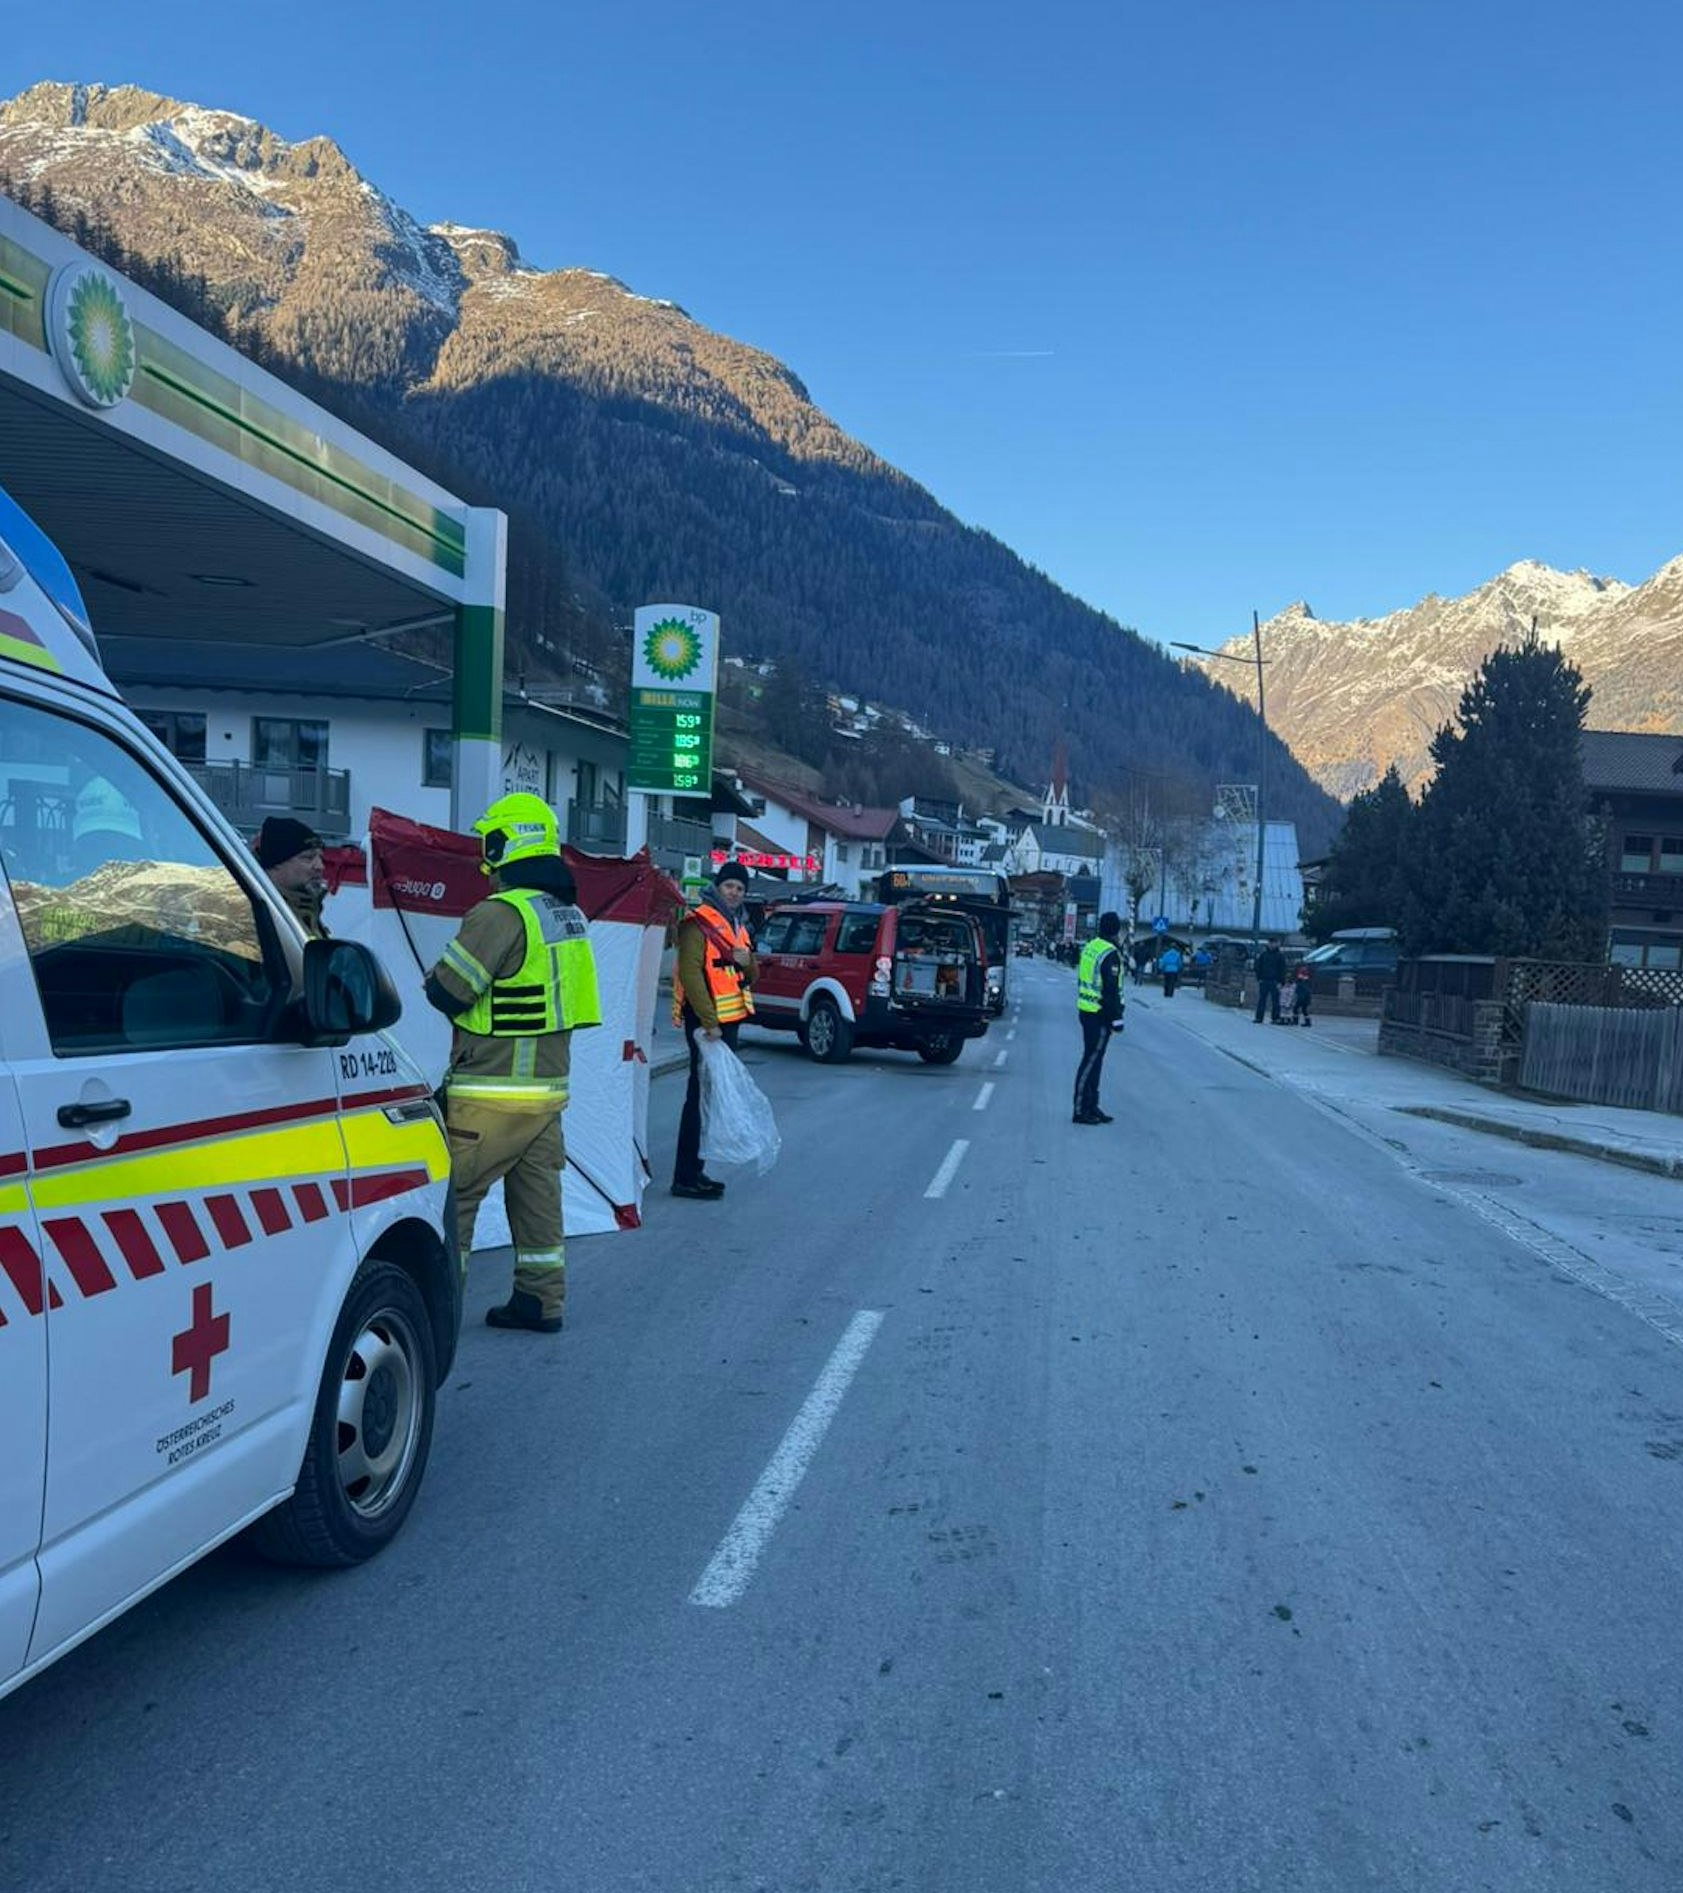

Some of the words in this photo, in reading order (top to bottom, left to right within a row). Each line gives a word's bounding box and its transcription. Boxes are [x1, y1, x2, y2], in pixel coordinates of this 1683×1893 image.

[690, 610, 707, 625] bp
[340, 1053, 359, 1079] RD
[360, 1049, 397, 1077] 14-228
[156, 1398, 236, 1454] ÖSTERREICHISCHES
[167, 1440, 195, 1465] ROTES
[196, 1424, 222, 1448] KREUZ
